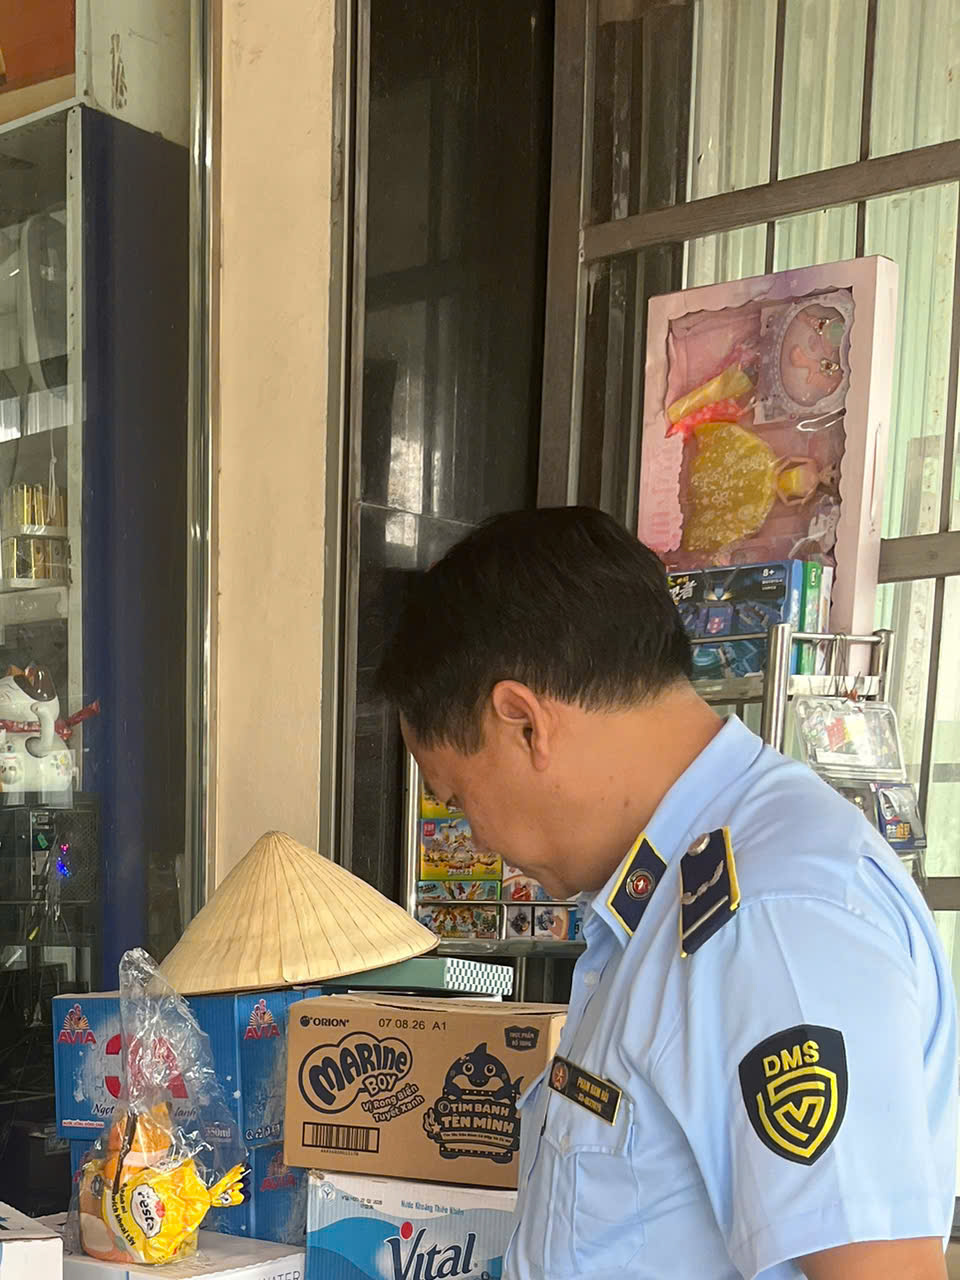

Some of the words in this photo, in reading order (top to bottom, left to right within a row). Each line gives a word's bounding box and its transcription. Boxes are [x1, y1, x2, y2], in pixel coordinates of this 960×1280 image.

[243, 1026, 281, 1042] AVIA
[311, 1017, 347, 1028] ORION
[378, 1018, 392, 1029] 07
[432, 1020, 448, 1032] A1
[57, 1029, 97, 1045] AVIA
[762, 1040, 820, 1078] DMS
[362, 1071, 397, 1098] BOY
[373, 1094, 397, 1111] Rong
[396, 1082, 420, 1100] Biển
[450, 1101, 474, 1113] TÌM
[373, 1106, 400, 1124] Tuyết
[398, 1094, 426, 1114] Xanh
[441, 1112, 472, 1129] TÊN
[473, 1114, 515, 1134] MÌNH
